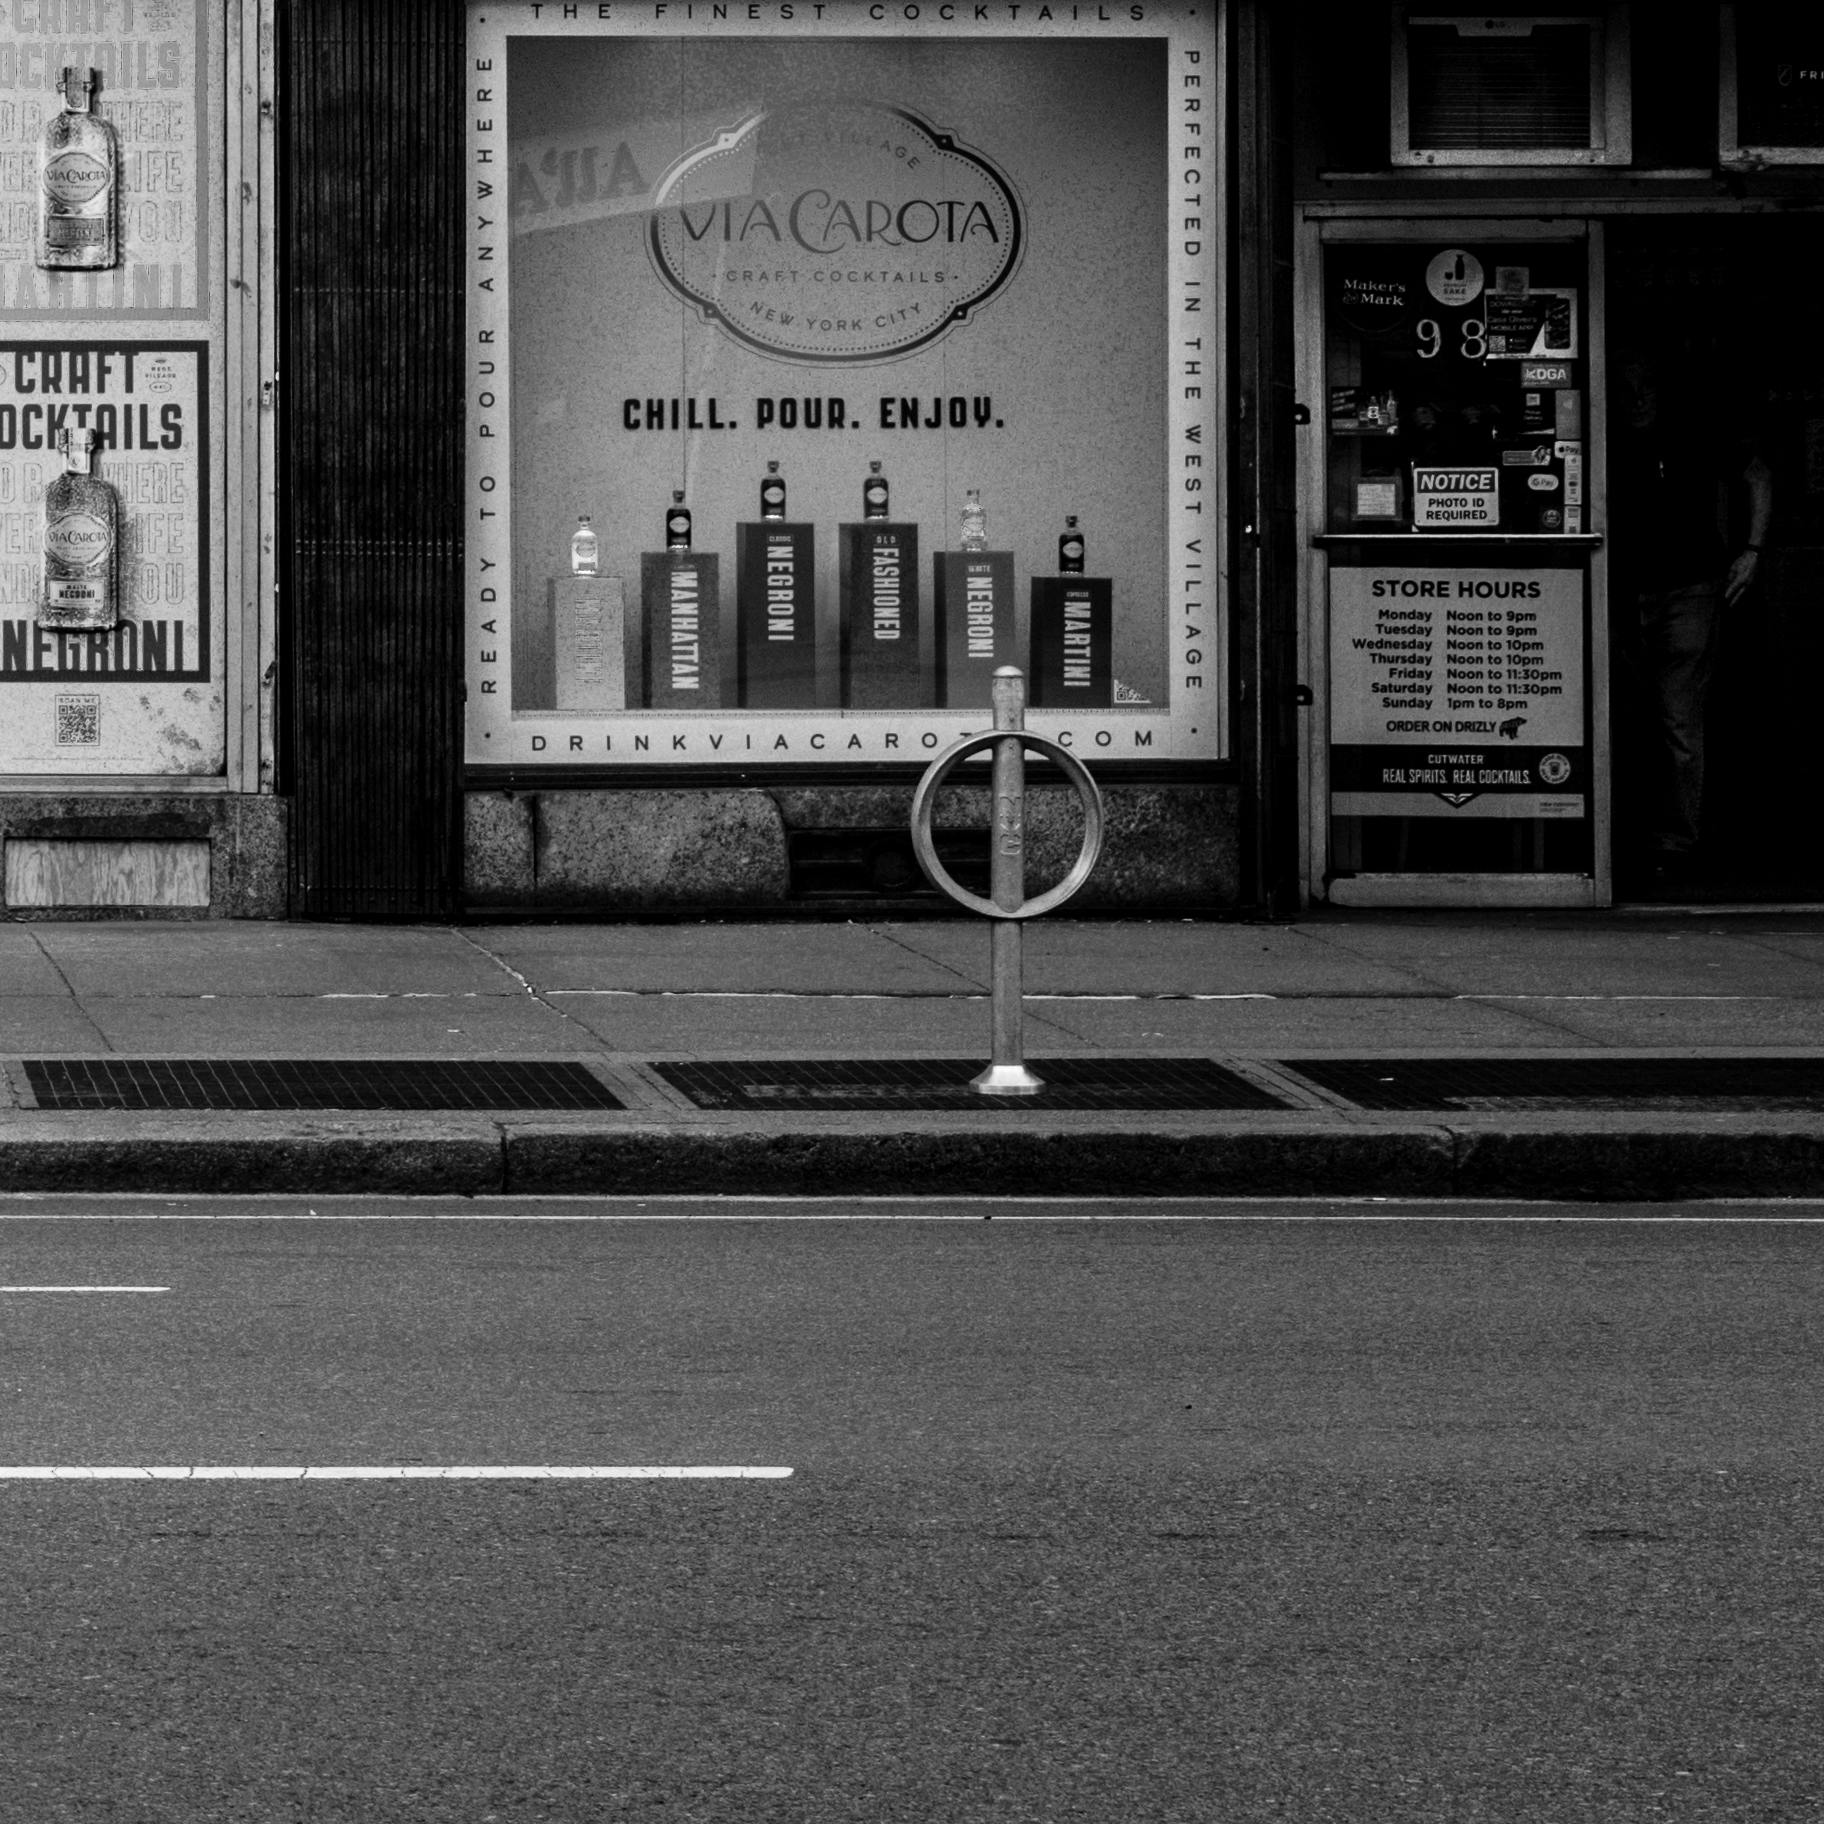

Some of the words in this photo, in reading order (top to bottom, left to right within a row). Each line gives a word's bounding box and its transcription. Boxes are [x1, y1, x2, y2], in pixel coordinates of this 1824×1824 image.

[532, 4, 610, 21] THE
[656, 5, 827, 21] FINEST
[870, 4, 1146, 21] COCKTAILS
[1184, 51, 1200, 257] PERFECTED
[477, 57, 495, 291] ANYWHERE
[680, 200, 781, 242] VIA
[789, 189, 999, 254] CAROTA
[727, 271, 797, 283] CRAFT
[814, 271, 945, 283] COCKTAILS
[1343, 278, 1406, 292] Maker's
[1184, 282, 1200, 312] IN
[1360, 292, 1404, 306] Mark
[750, 301, 794, 326] NEW
[808, 318, 864, 331] YORK
[875, 302, 921, 326] CITY
[1416, 319, 1441, 358] 9
[1461, 319, 1487, 358] 8
[1185, 331, 1200, 398] THE
[480, 327, 495, 437] POUR
[623, 397, 737, 431] CHILL.
[757, 397, 860, 431] POUR.
[880, 397, 1005, 431] ENJOY.
[1185, 426, 1201, 514] WEST
[1420, 474, 1491, 490] NOTICE
[481, 477, 496, 520] TO
[1428, 498, 1469, 508] PHOTO
[1472, 498, 1484, 508] ID
[1426, 510, 1488, 521] REQUIRED
[767, 547, 793, 642] NEGRONI
[873, 547, 900, 641] FASHIONED
[1372, 580, 1450, 597] STORE
[1458, 581, 1541, 598] HOURS
[967, 576, 993, 659] NEGRONI
[1187, 540, 1202, 690] VILLAGE
[1378, 609, 1432, 621] Monday
[1447, 610, 1483, 620] Noon
[1488, 611, 1502, 620] to
[1507, 611, 1537, 622] 9pm
[481, 558, 498, 694] READY
[671, 571, 699, 690] MANHATTAN
[1375, 624, 1432, 636] Tuesday
[1447, 625, 1483, 635] Noon
[1488, 626, 1502, 635] to
[1507, 626, 1537, 637] 9pm
[1064, 601, 1091, 687] MARTINI
[1352, 639, 1432, 651] Wednesday
[1447, 639, 1483, 649] Noon
[1488, 640, 1502, 649] to
[1507, 640, 1544, 651] 10pm
[1370, 653, 1432, 665] Thursday
[1447, 654, 1483, 664] Noon
[1488, 655, 1502, 664] to
[1507, 655, 1544, 666] 10pm
[1389, 667, 1432, 679] Friday
[1447, 668, 1483, 678] Noon
[1488, 669, 1502, 678] to
[1507, 669, 1562, 680] 11:30pm
[1371, 682, 1432, 694] Saturday
[1447, 683, 1483, 693] Noon
[1488, 684, 1502, 693] to
[1507, 684, 1562, 695] 11:30pm
[1382, 697, 1432, 709] Sunday
[1447, 698, 1474, 709] 1pm
[1479, 699, 1493, 708] to
[1497, 699, 1528, 710] 8pm
[1386, 721, 1430, 732] ORDER
[1433, 721, 1452, 732] ON
[1455, 721, 1496, 733] DRIZLY
[532, 731, 1153, 752] DRINKVIACAROCOM
[1428, 754, 1483, 764] CUTWATER
[1382, 769, 1406, 783] REAL
[1409, 769, 1448, 784] SPIRITS.
[1453, 769, 1475, 784] REAL
[1479, 770, 1532, 784] COCKTAILS.
